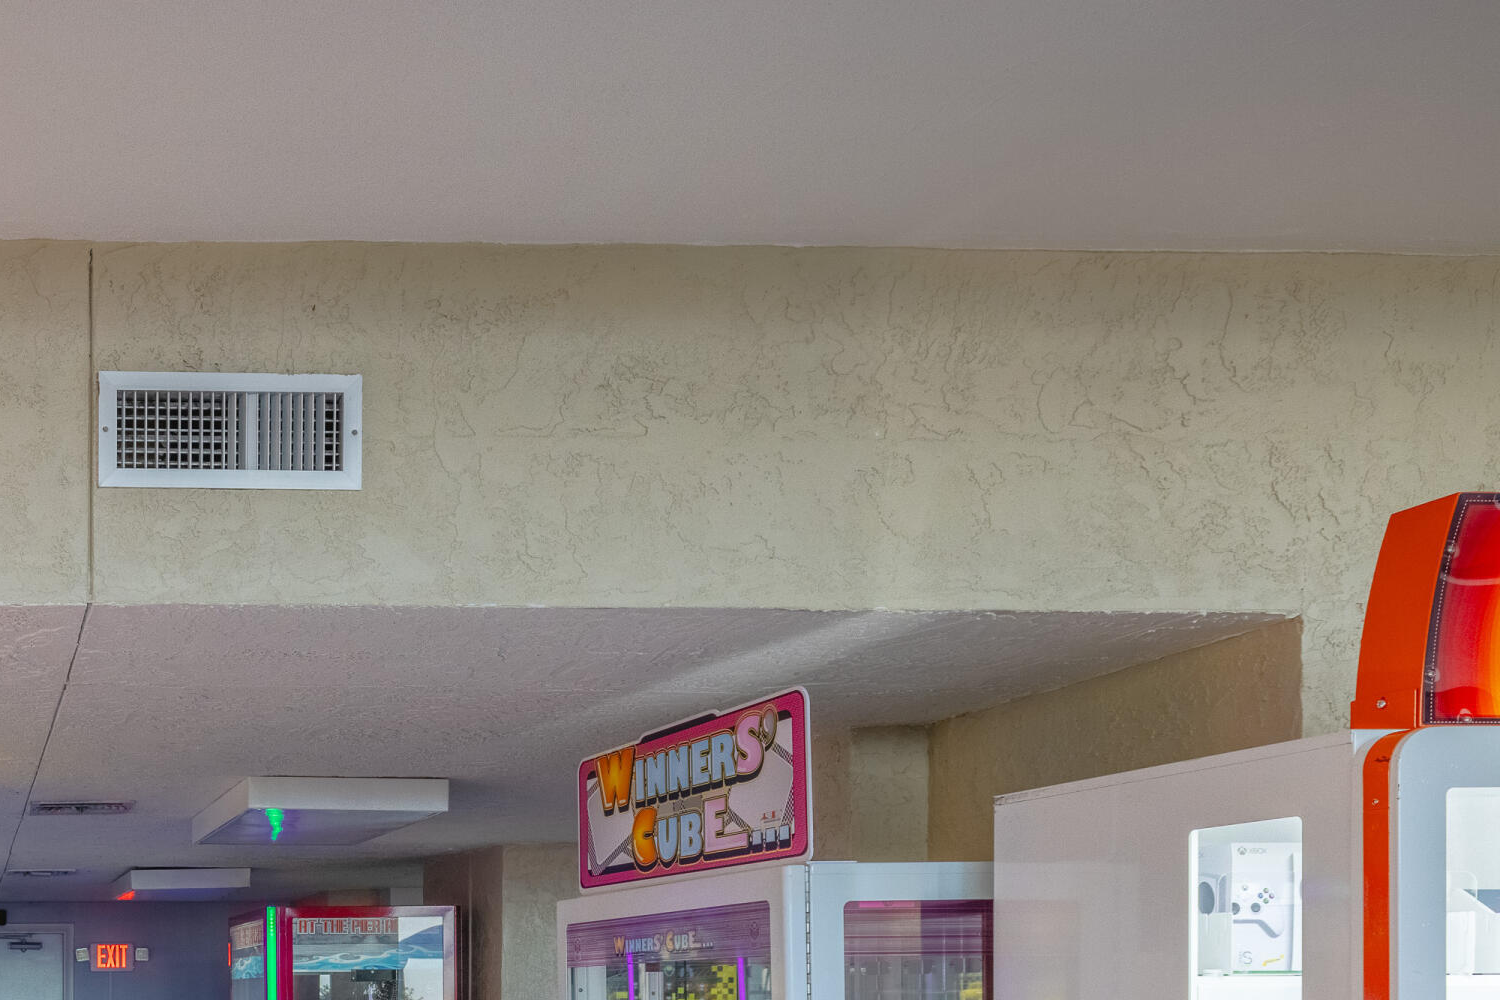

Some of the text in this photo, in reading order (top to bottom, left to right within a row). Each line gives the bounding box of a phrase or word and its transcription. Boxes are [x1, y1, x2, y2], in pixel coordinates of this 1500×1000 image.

[297, 918, 316, 935] AT
[323, 918, 349, 935] THE
[97, 943, 129, 969] EXIT
